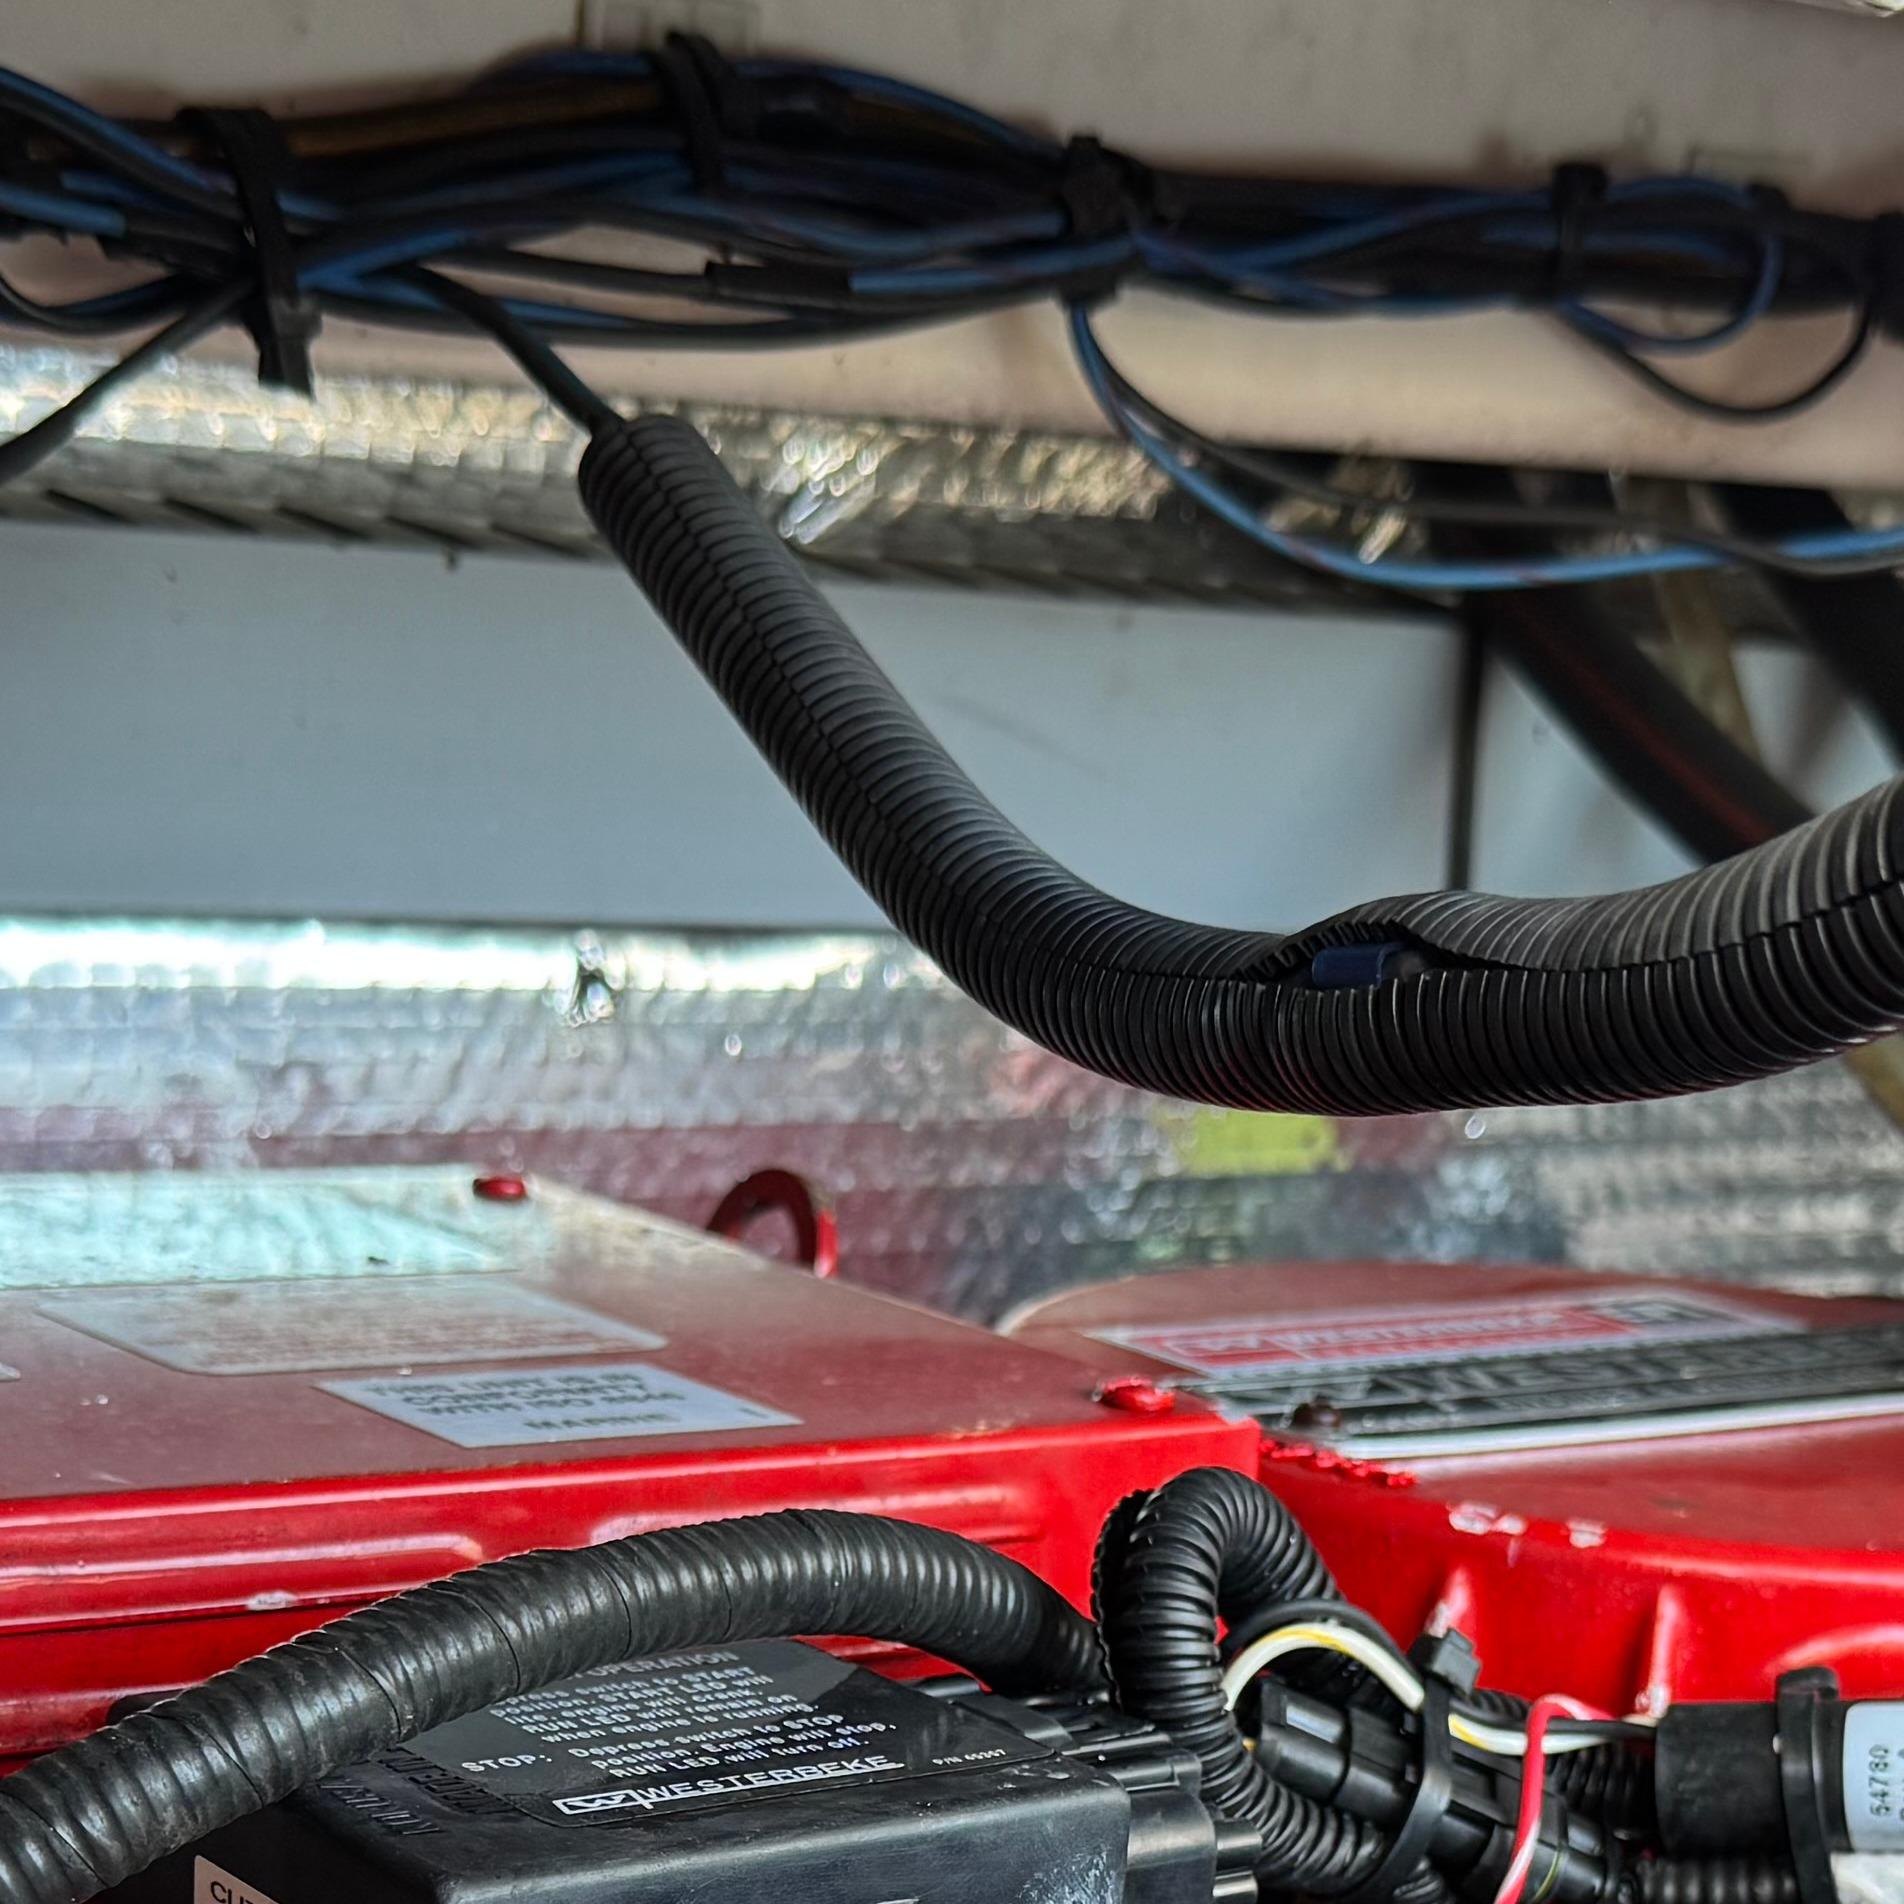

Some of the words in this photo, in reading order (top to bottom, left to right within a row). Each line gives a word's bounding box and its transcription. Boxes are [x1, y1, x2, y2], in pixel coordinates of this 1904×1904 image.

[575, 1680, 649, 1695] switch
[652, 1678, 679, 1686] to
[682, 1666, 755, 1682] START
[598, 1687, 674, 1702] START
[678, 1681, 727, 1693] LED
[732, 1675, 774, 1687] will
[522, 1721, 578, 1734] RUN
[581, 1713, 631, 1726] LED
[637, 1707, 680, 1719] will
[685, 1700, 763, 1714] remain
[768, 1694, 798, 1704] on
[541, 1728, 607, 1743] when
[612, 1719, 691, 1733] engine
[692, 1714, 719, 1723] is
[723, 1703, 819, 1719] running.
[561, 1702, 640, 1718] engine
[644, 1696, 687, 1707] will
[462, 1754, 552, 1772] STOP:
[568, 1739, 670, 1757] Depress
[674, 1727, 752, 1744] switch
[753, 1725, 781, 1733] to
[783, 1714, 844, 1729] STOP
[592, 1749, 698, 1769] position.
[701, 1736, 785, 1752] Engine
[788, 1727, 832, 1741] will
[609, 1762, 667, 1778] RUN
[669, 1756, 720, 1770] LED
[725, 1750, 770, 1763] will
[771, 1743, 824, 1756] turn
[827, 1736, 869, 1750] off.
[637, 1755, 888, 1800] WESTERBEKE
